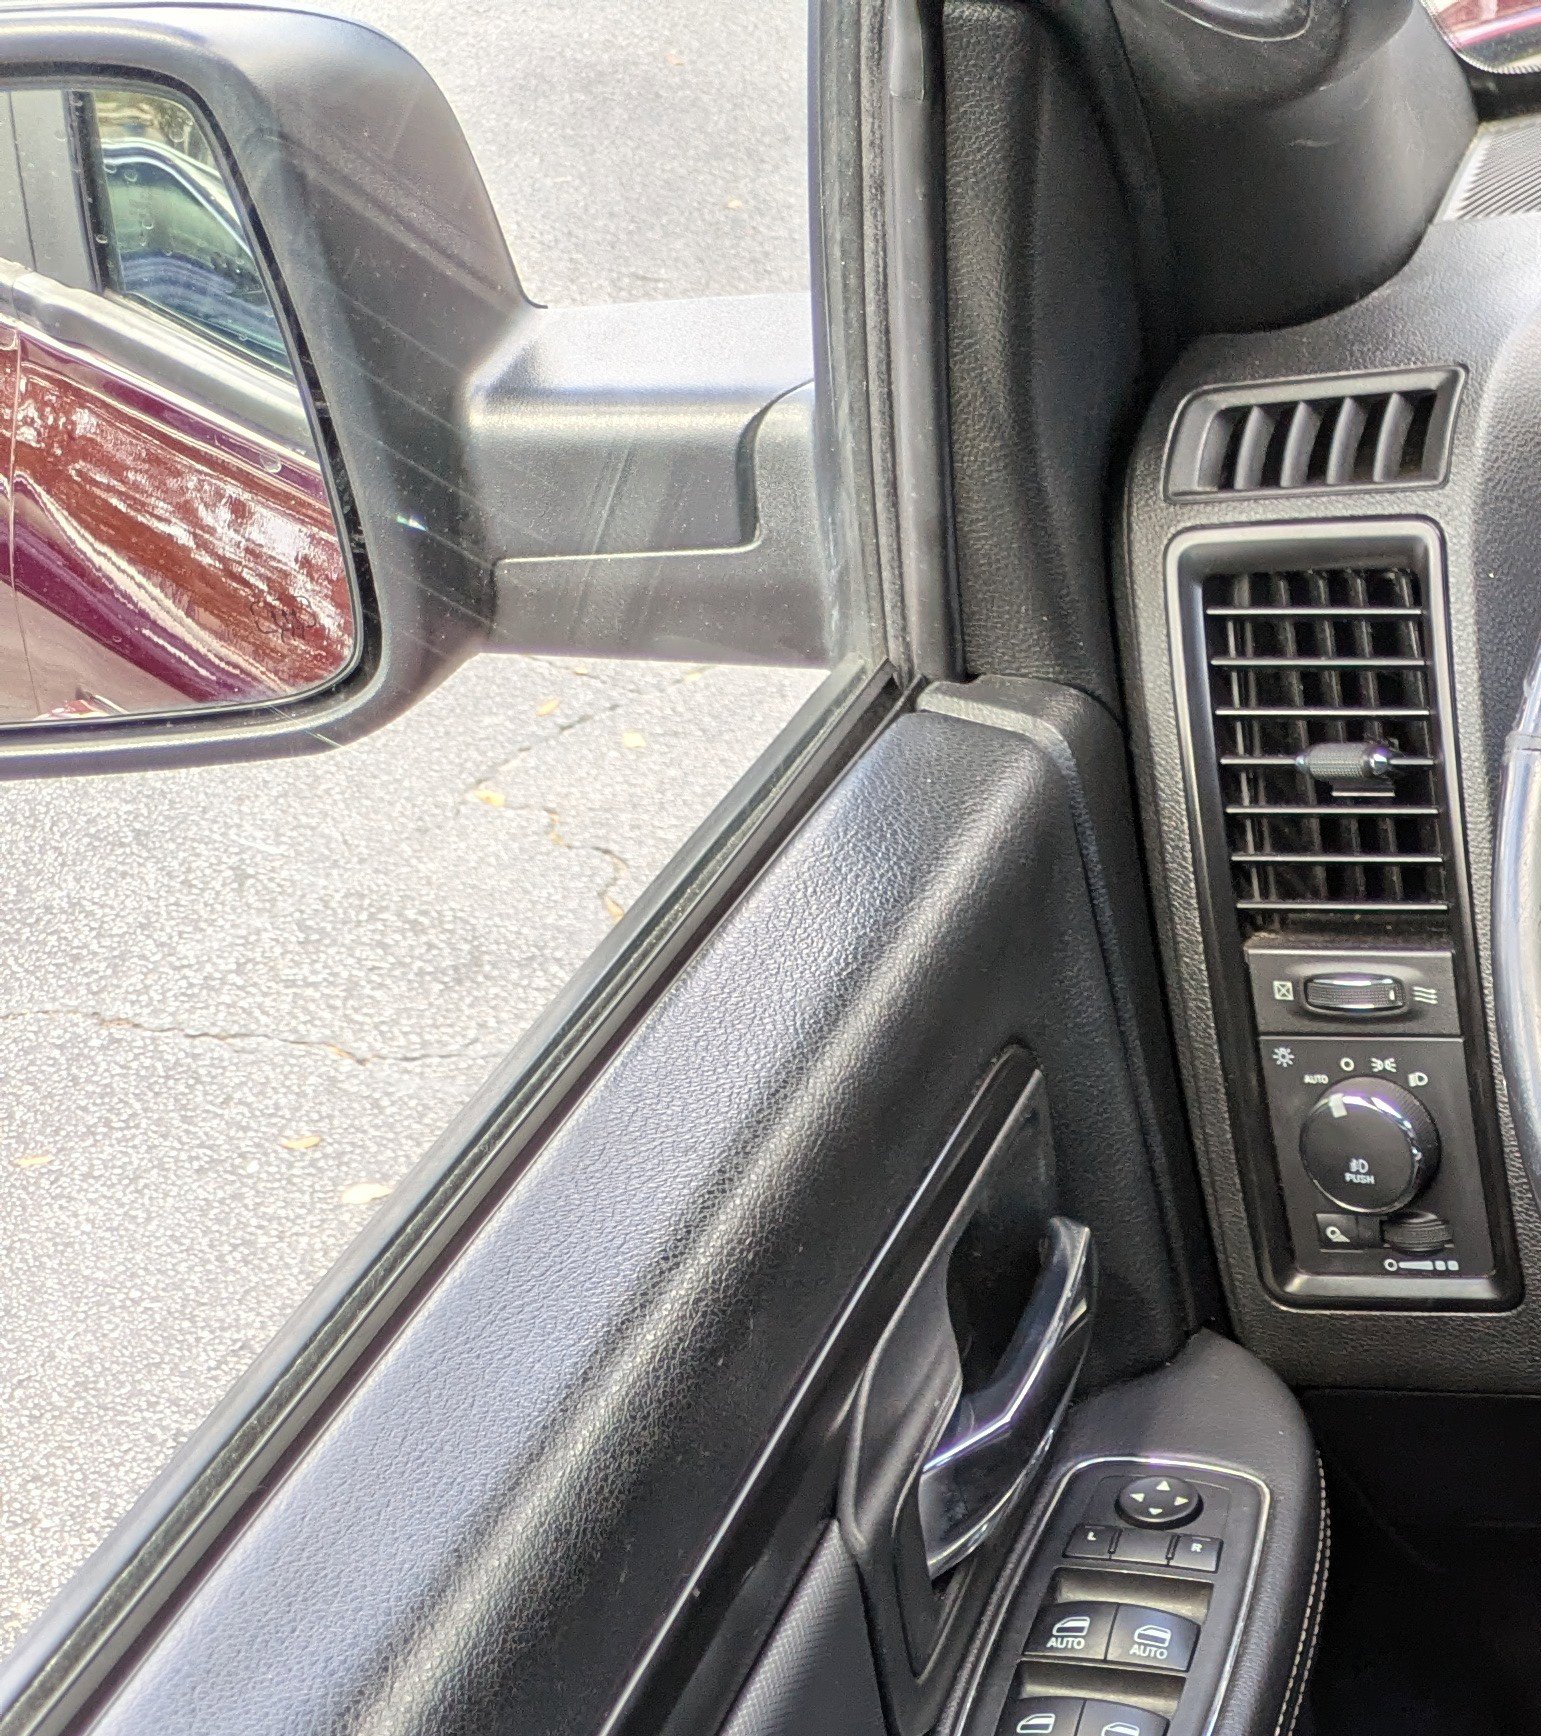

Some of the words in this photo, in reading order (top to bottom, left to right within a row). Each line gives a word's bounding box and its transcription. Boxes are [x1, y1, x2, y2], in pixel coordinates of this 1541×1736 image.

[1303, 1073, 1329, 1085] AUTO
[1344, 1172, 1375, 1185] PUSH
[1086, 1531, 1097, 1541] L
[1190, 1542, 1203, 1552] R
[1046, 1635, 1085, 1651] AUTO
[1128, 1643, 1168, 1660] AUTO
